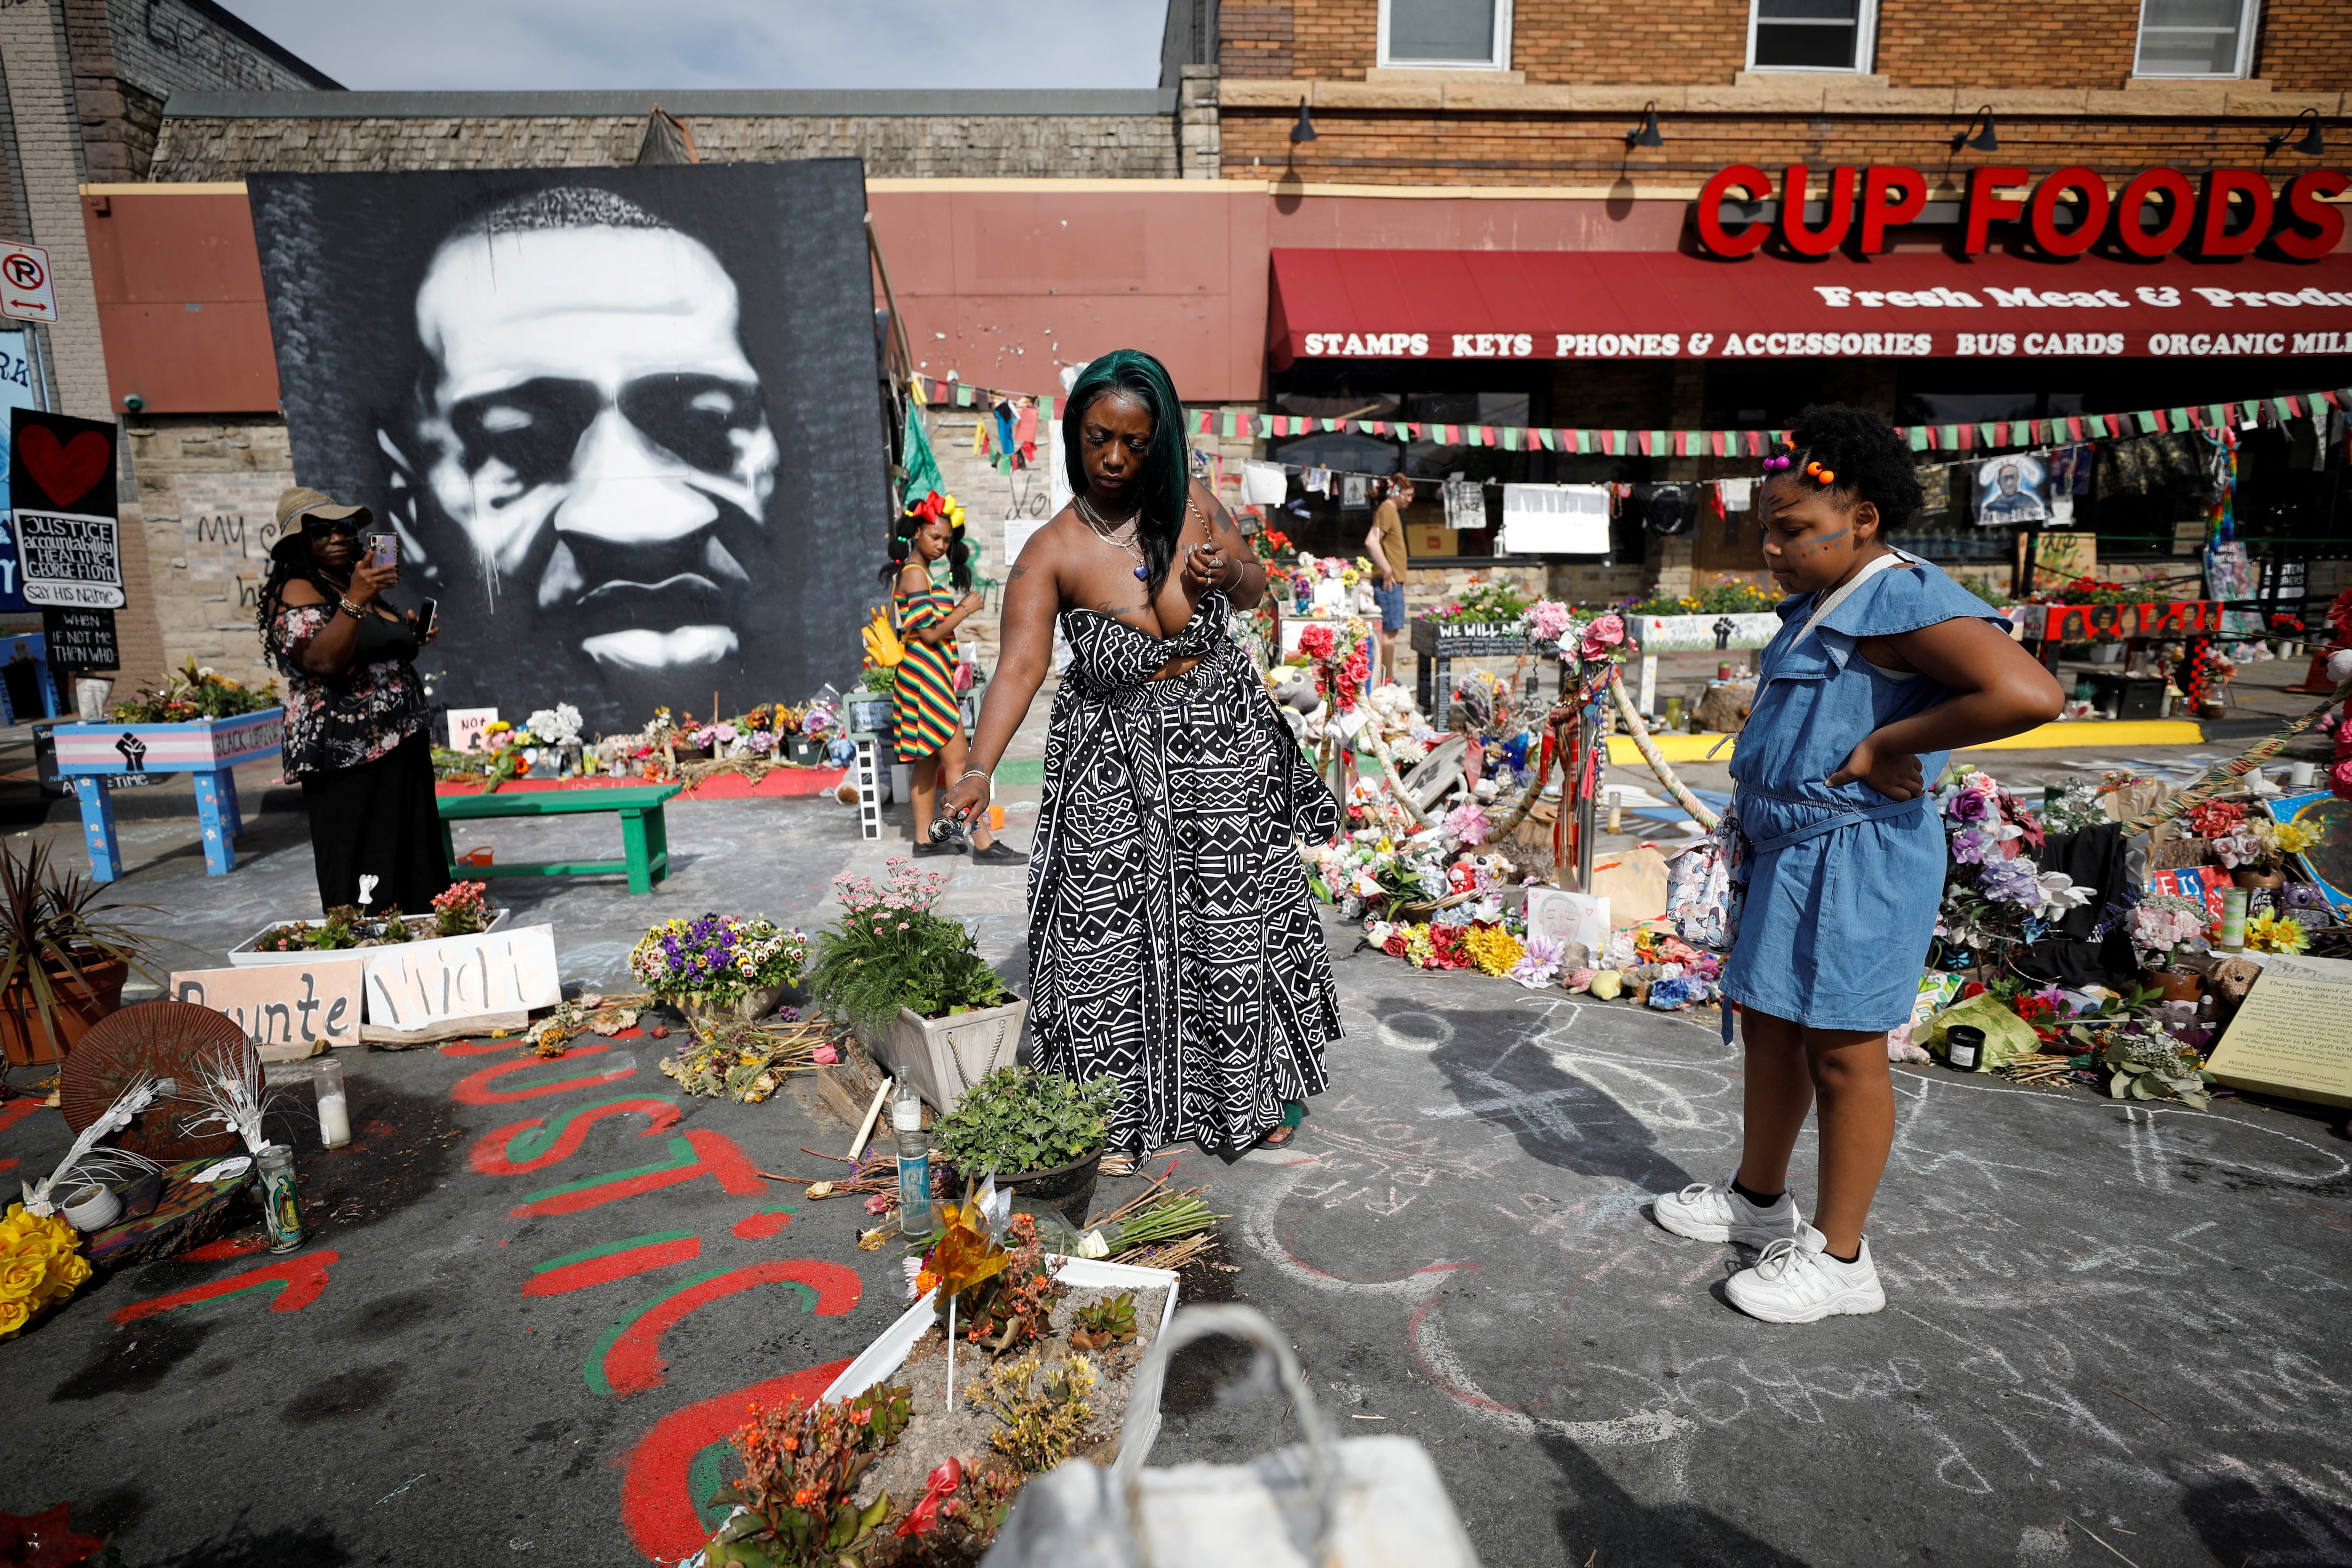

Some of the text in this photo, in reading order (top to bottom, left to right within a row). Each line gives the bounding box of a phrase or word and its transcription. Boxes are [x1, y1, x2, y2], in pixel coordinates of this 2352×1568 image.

[1697, 163, 2352, 260] CUP FOODS
[1813, 286, 1983, 309] Fresh
[1983, 286, 2131, 309] Meat
[2134, 286, 2183, 309] &
[1305, 333, 1429, 356] STAMPS
[1452, 334, 1533, 357] KEYS
[1555, 333, 1680, 357] PHONES
[1687, 333, 1714, 356] &
[1721, 333, 1932, 356] ACCESSORIES
[1955, 333, 2016, 356] BUS
[2023, 333, 2125, 355] CARDS
[2148, 333, 2285, 356] ORGANIC
[25, 516, 111, 541] JUSTICE
[24, 535, 113, 559] accountability
[37, 549, 107, 566] HEALING
[28, 561, 116, 581] GEORGE FLOYD
[54, 586, 74, 600] HIS
[52, 631, 63, 643] IF
[66, 630, 91, 643] NOT
[1438, 624, 1462, 638] WE
[1463, 622, 1500, 638] WILL
[214, 729, 247, 758] BLACK
[2305, 985, 2339, 994] beloved
[2297, 997, 2334, 1005] therefrom
[2290, 1022, 2327, 1031] knowledge
[2240, 1031, 2265, 1039] Verily
[2280, 1031, 2315, 1040] behooveth
[2229, 1065, 2251, 1074] George
[2305, 1078, 2346, 1088] communities
[2278, 1068, 2305, 1077] prayers
[2319, 1075, 2344, 1083] justice
